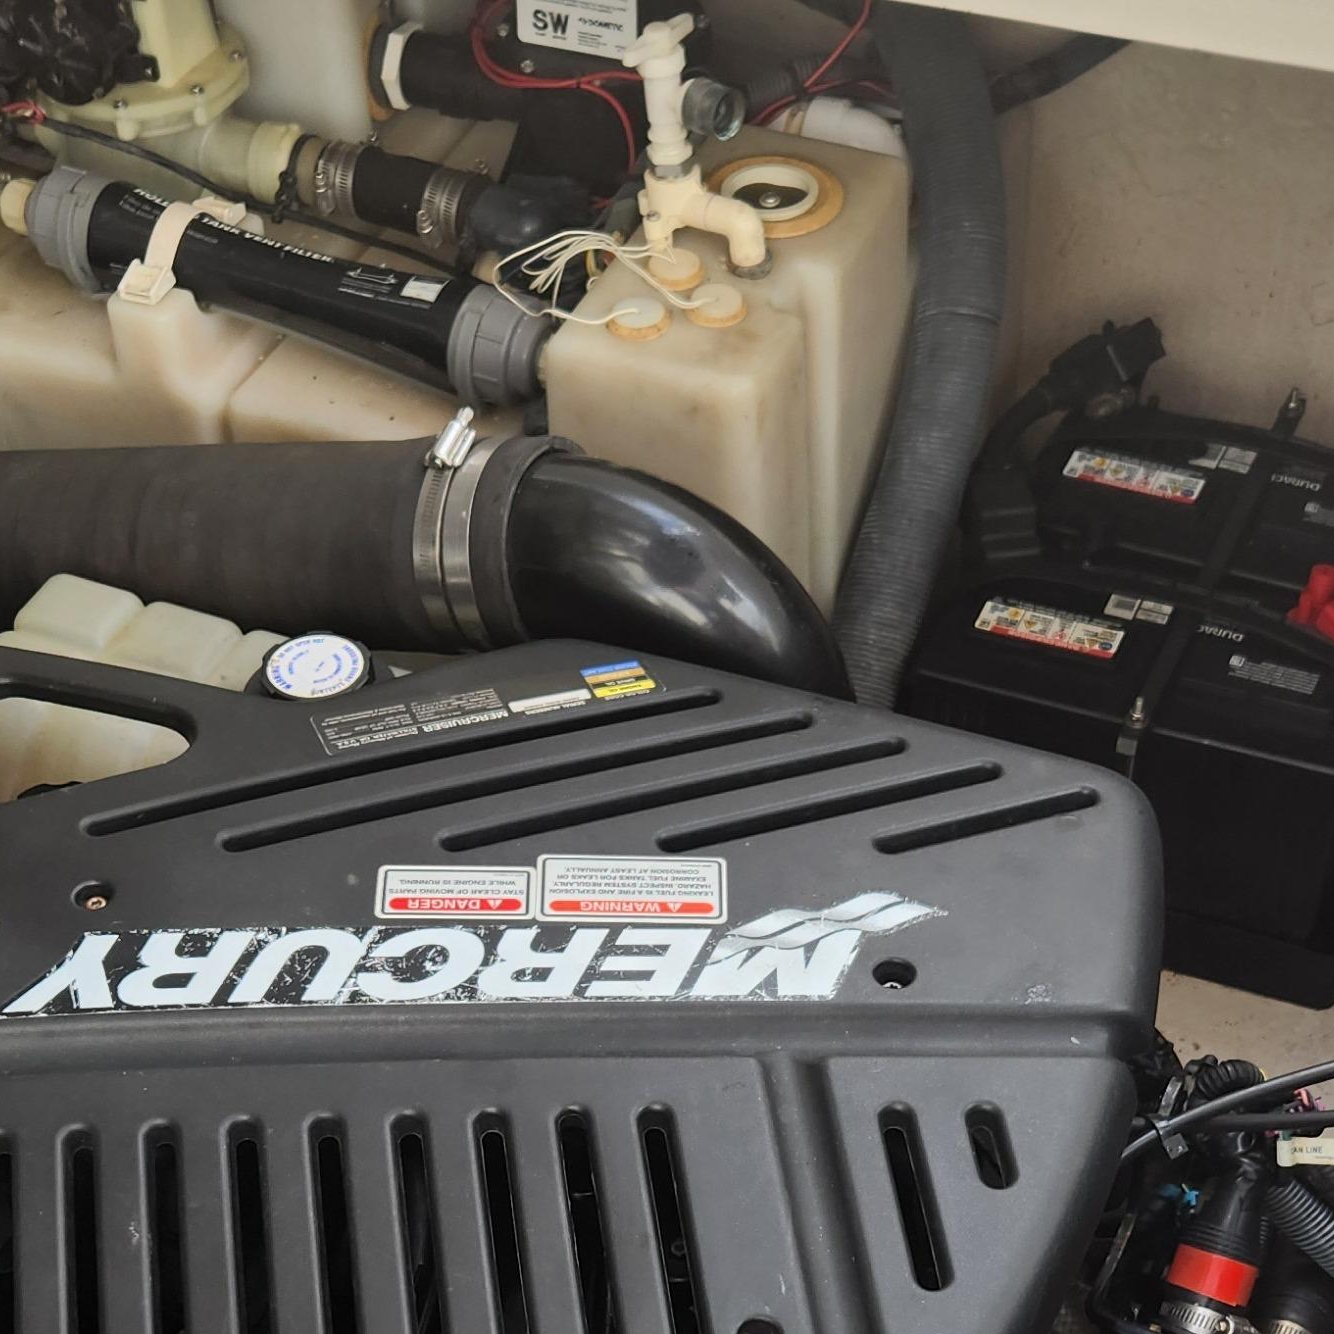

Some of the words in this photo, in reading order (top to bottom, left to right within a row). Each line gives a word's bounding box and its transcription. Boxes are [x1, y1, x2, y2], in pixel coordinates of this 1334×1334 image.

[532, 9, 569, 36] SW
[201, 216, 240, 235] TANK
[243, 232, 282, 250] VENT
[422, 709, 509, 732] MERCRUISER
[407, 899, 481, 910] DANGER
[580, 901, 661, 912] WARNING
[0, 917, 867, 1015] MERCURY
